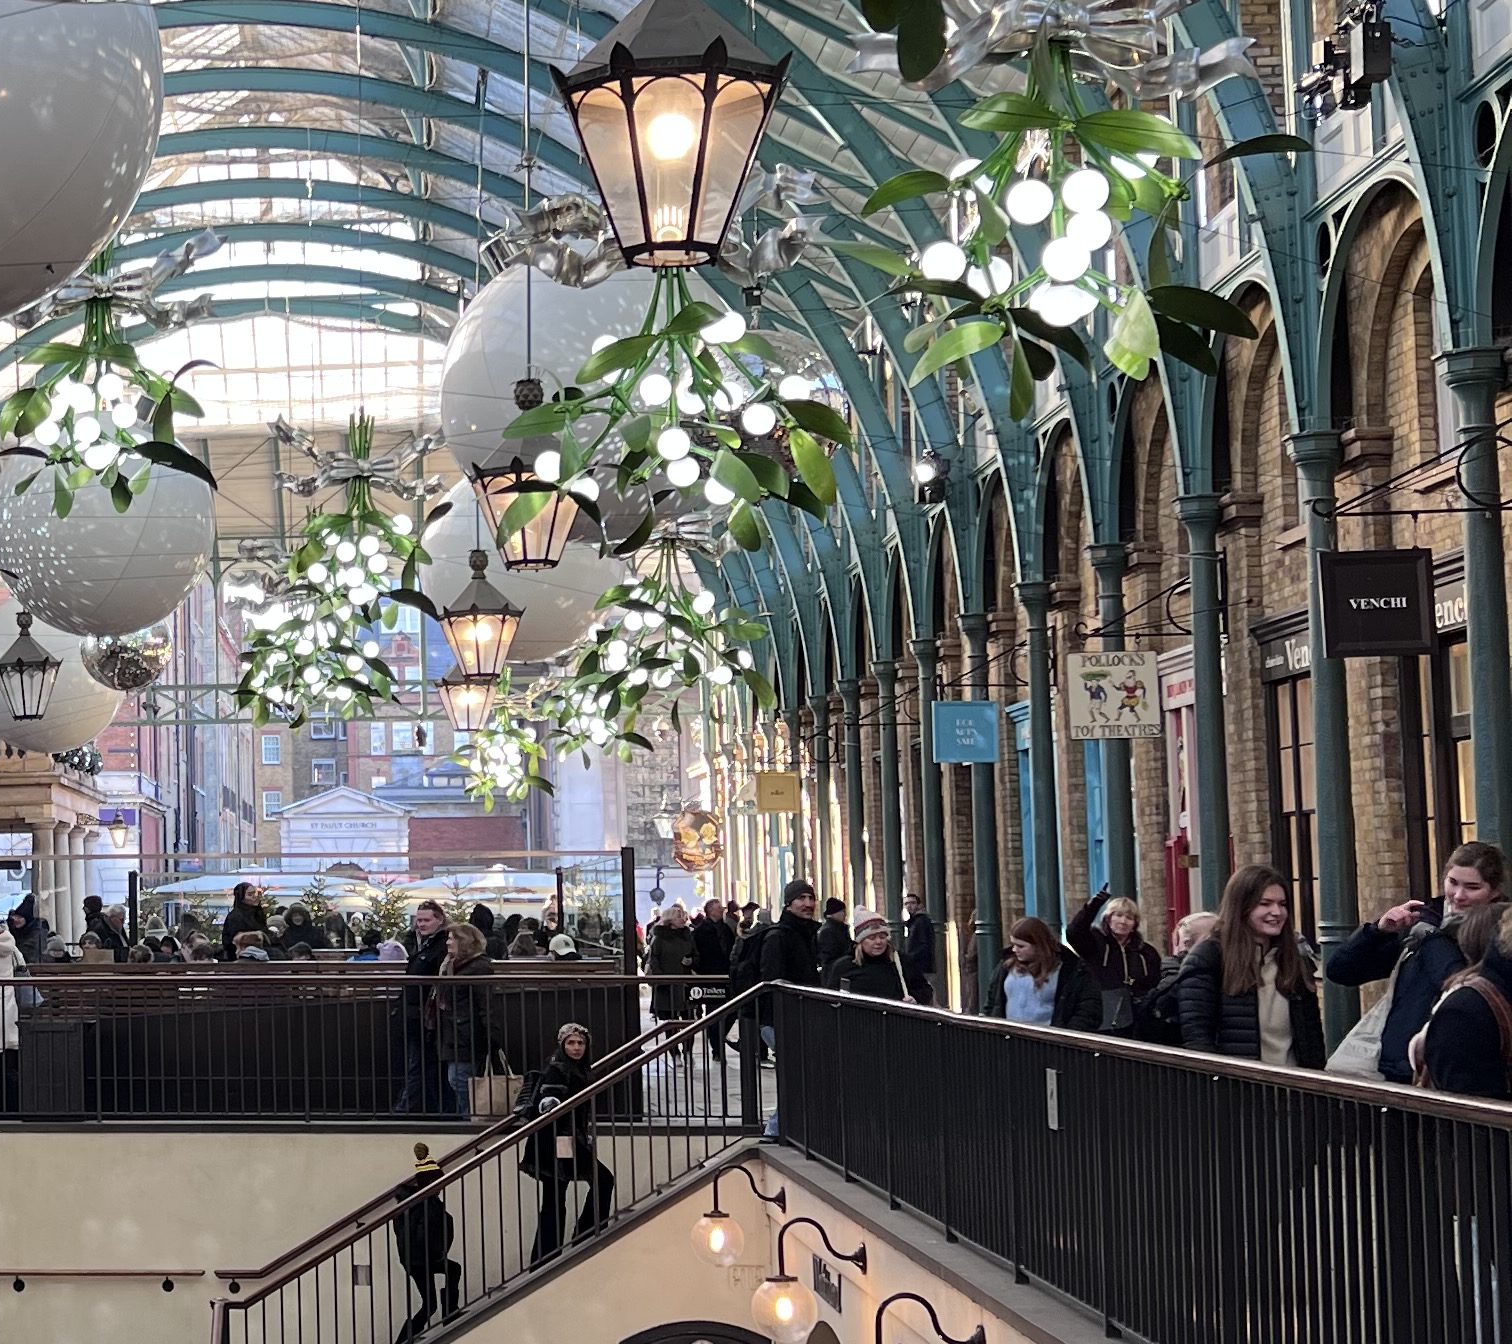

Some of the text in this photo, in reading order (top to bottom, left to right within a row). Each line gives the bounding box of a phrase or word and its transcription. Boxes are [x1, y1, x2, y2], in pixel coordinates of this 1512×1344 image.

[1348, 596, 1408, 611] VENCHI
[1434, 584, 1468, 629] enc
[1284, 638, 1311, 671] Ven
[1073, 723, 1162, 738] TOY THEATRES
